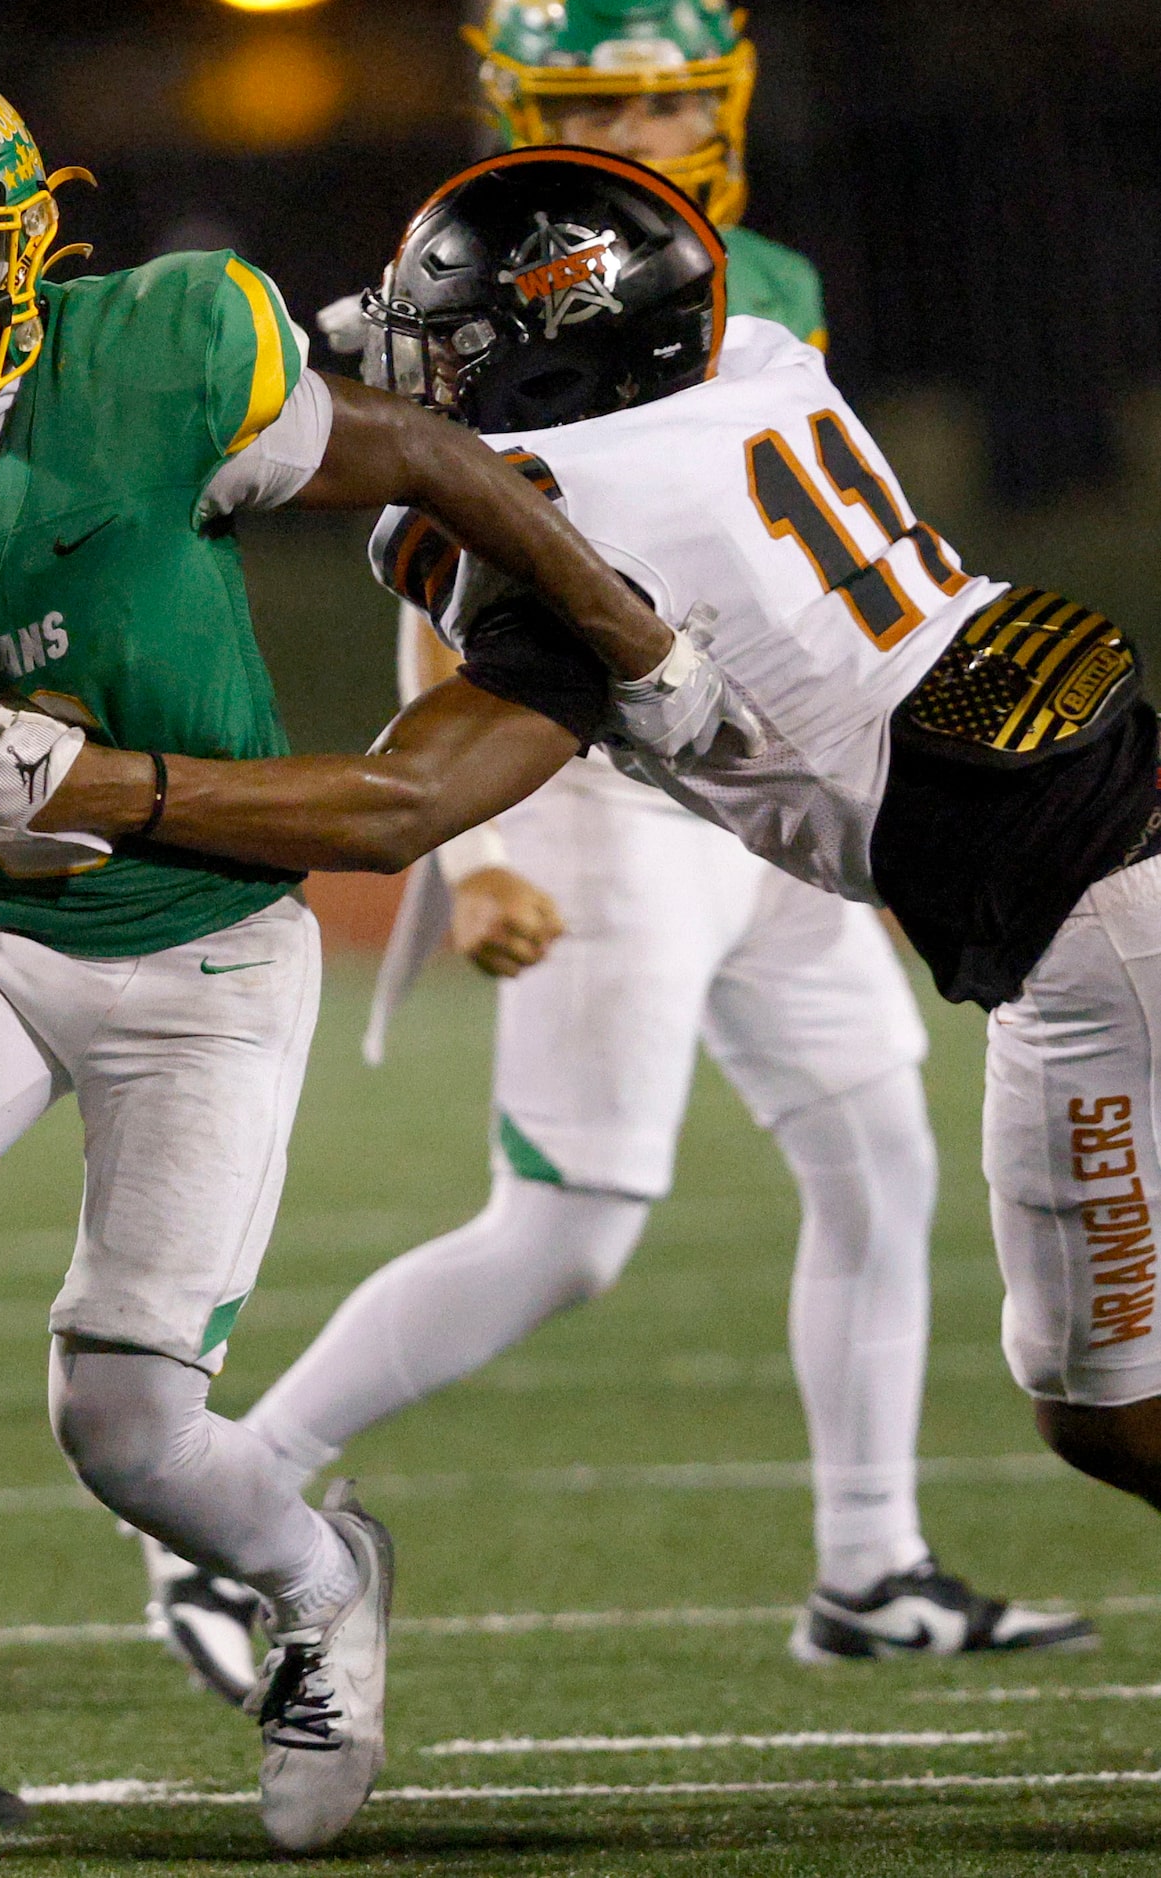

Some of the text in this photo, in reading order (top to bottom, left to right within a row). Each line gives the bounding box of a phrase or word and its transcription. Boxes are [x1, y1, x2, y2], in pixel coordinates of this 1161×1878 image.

[515, 244, 607, 301] WEST
[744, 407, 972, 652] 11
[1062, 648, 1121, 713] BATTLE
[1068, 1094, 1158, 1349] WRANGLERS
